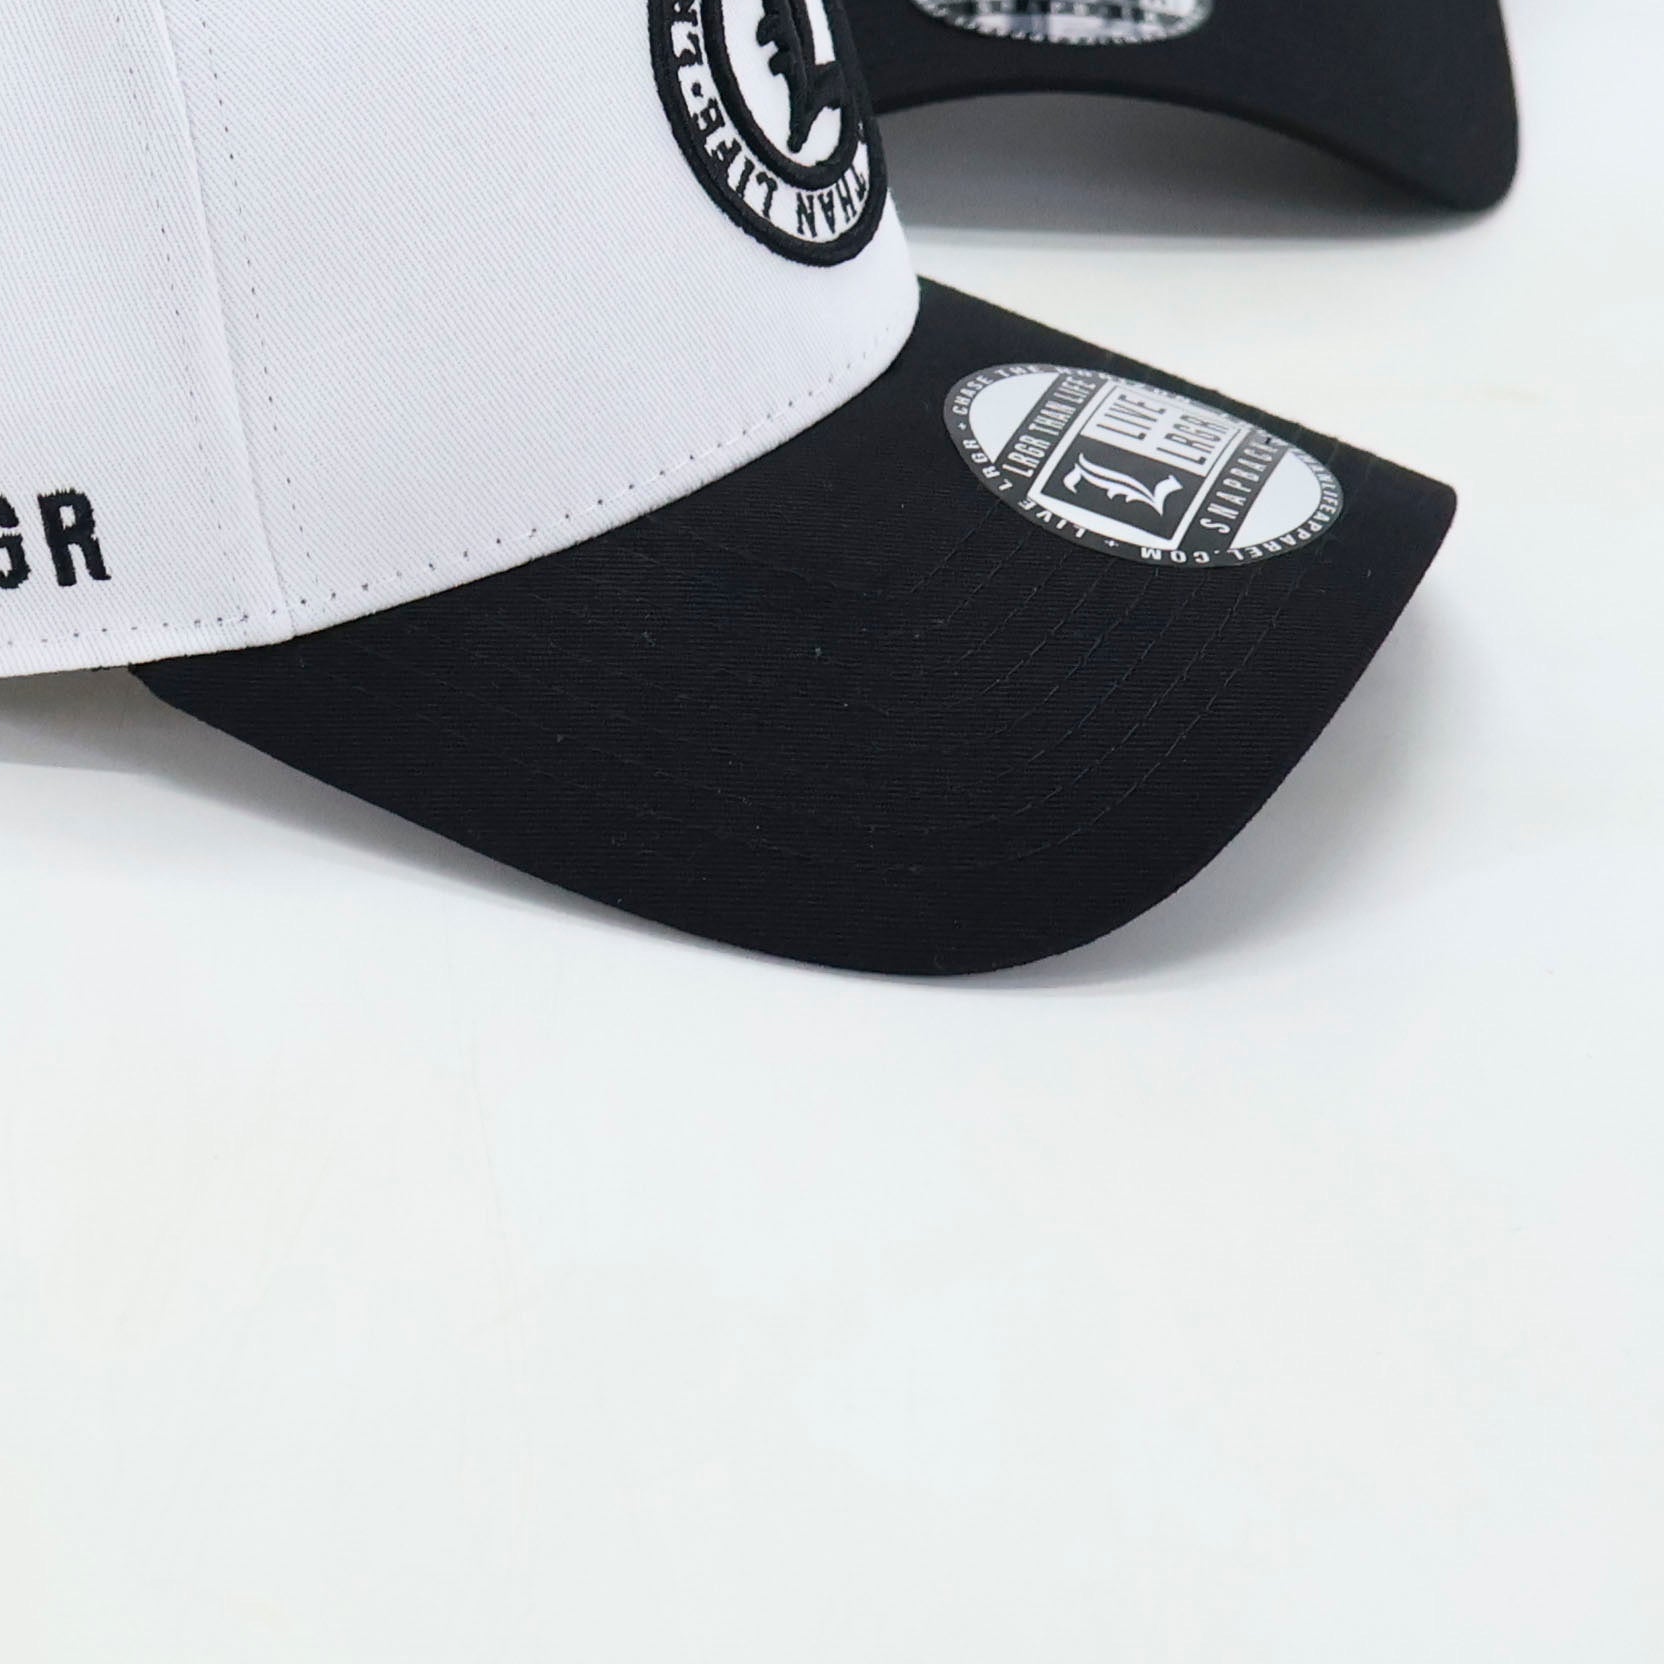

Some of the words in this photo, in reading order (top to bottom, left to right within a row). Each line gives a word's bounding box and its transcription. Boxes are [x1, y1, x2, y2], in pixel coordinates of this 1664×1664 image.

[691, 97, 778, 220] LIFE
[796, 162, 867, 238] THAN
[952, 374, 994, 416] CHASE
[1096, 393, 1166, 441] LIVE
[1002, 434, 1051, 478] LRGR
[1029, 400, 1077, 437] THAN
[1053, 376, 1096, 405] LIFE
[1156, 414, 1230, 466] LRGR
[962, 437, 1014, 492] LRGR
[1017, 496, 1087, 539] LIVE
